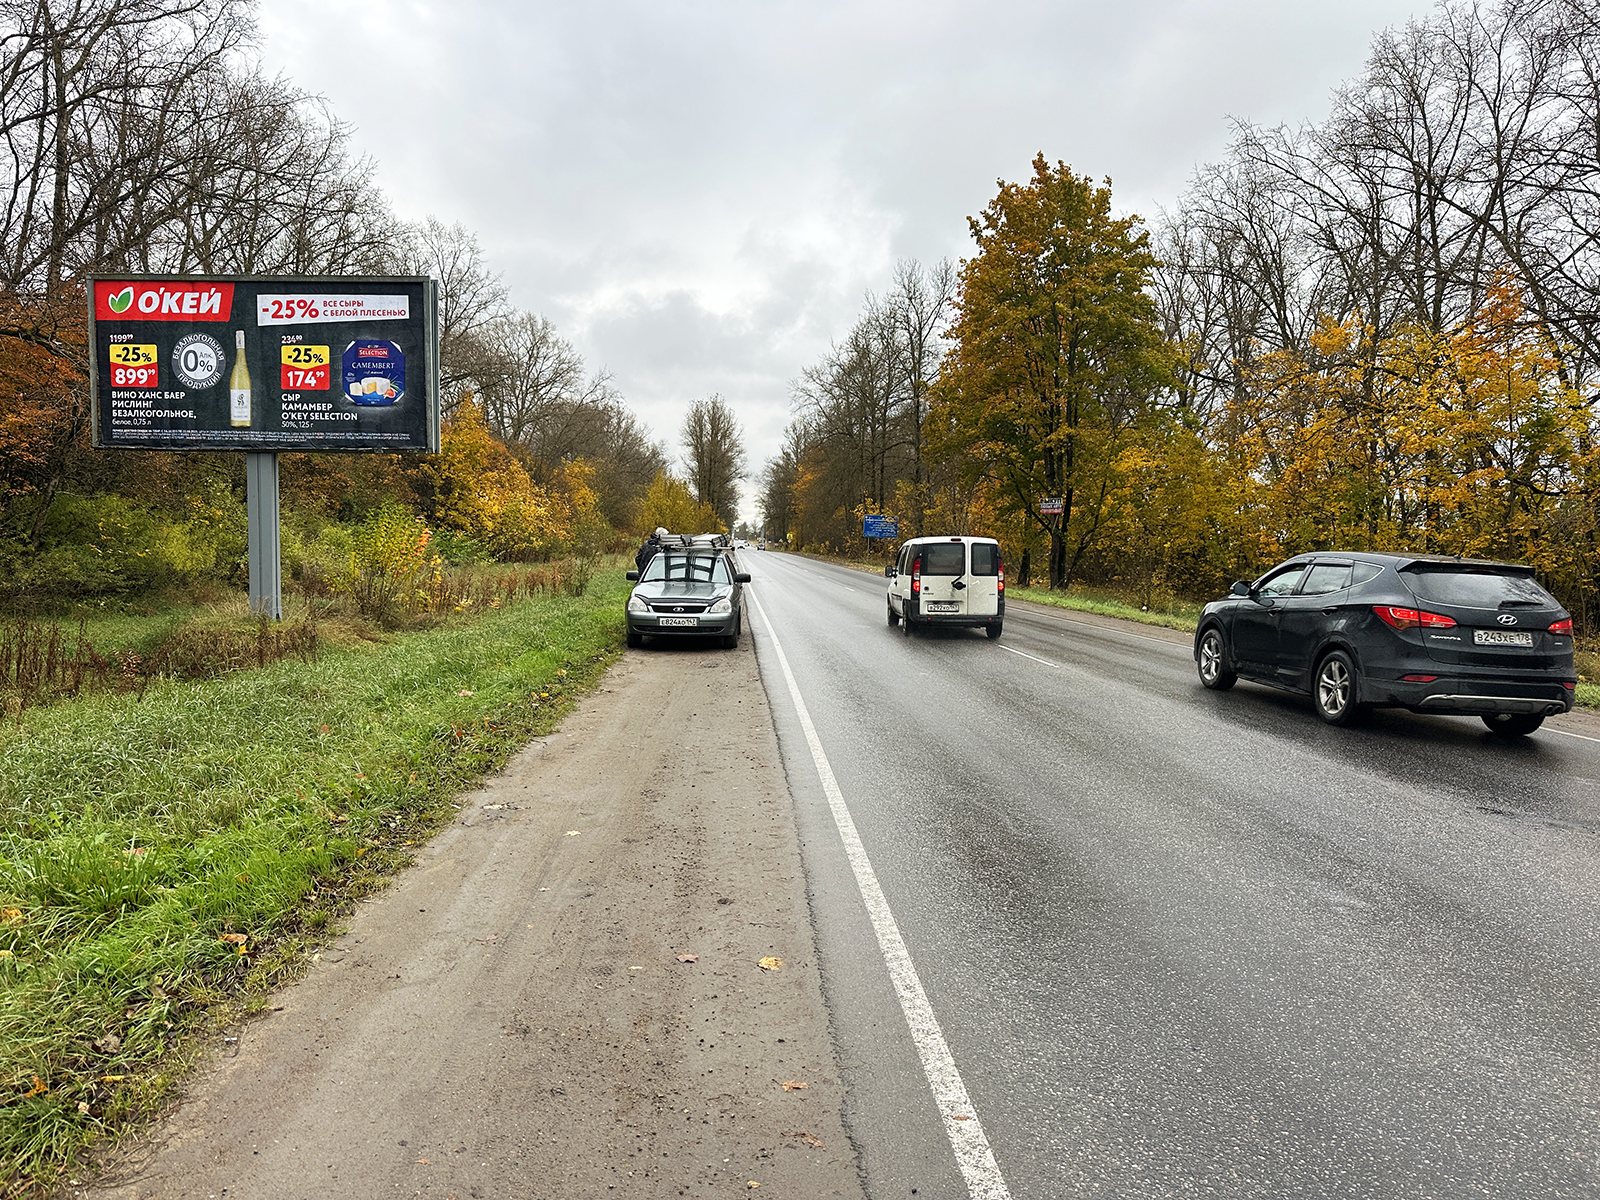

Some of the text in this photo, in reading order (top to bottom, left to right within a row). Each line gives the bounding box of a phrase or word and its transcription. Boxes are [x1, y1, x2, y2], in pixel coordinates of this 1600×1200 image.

[262, 299, 319, 319] -25%
[330, 308, 359, 317] БЕЛОЙ
[360, 309, 407, 317] ПЛЕСЕНЬЮ
[172, 334, 225, 361] БЕЗАЛКОГОЛЬНАЯ
[115, 346, 152, 362] -25%
[287, 347, 324, 363] -25%
[351, 361, 395, 369] CAMEMBERT
[177, 371, 222, 390] ПРОДУКЦИЯ
[111, 391, 186, 399] ВИНО ХАНС БАЕР
[281, 393, 301, 402] СЫР
[111, 400, 153, 408] РИСЛИНГ
[281, 403, 333, 411] КАМАМБЕР
[111, 409, 197, 419] БЕЗАЛКОГОЛЬНОЕ,
[281, 412, 358, 421] O'KEY SELECTION
